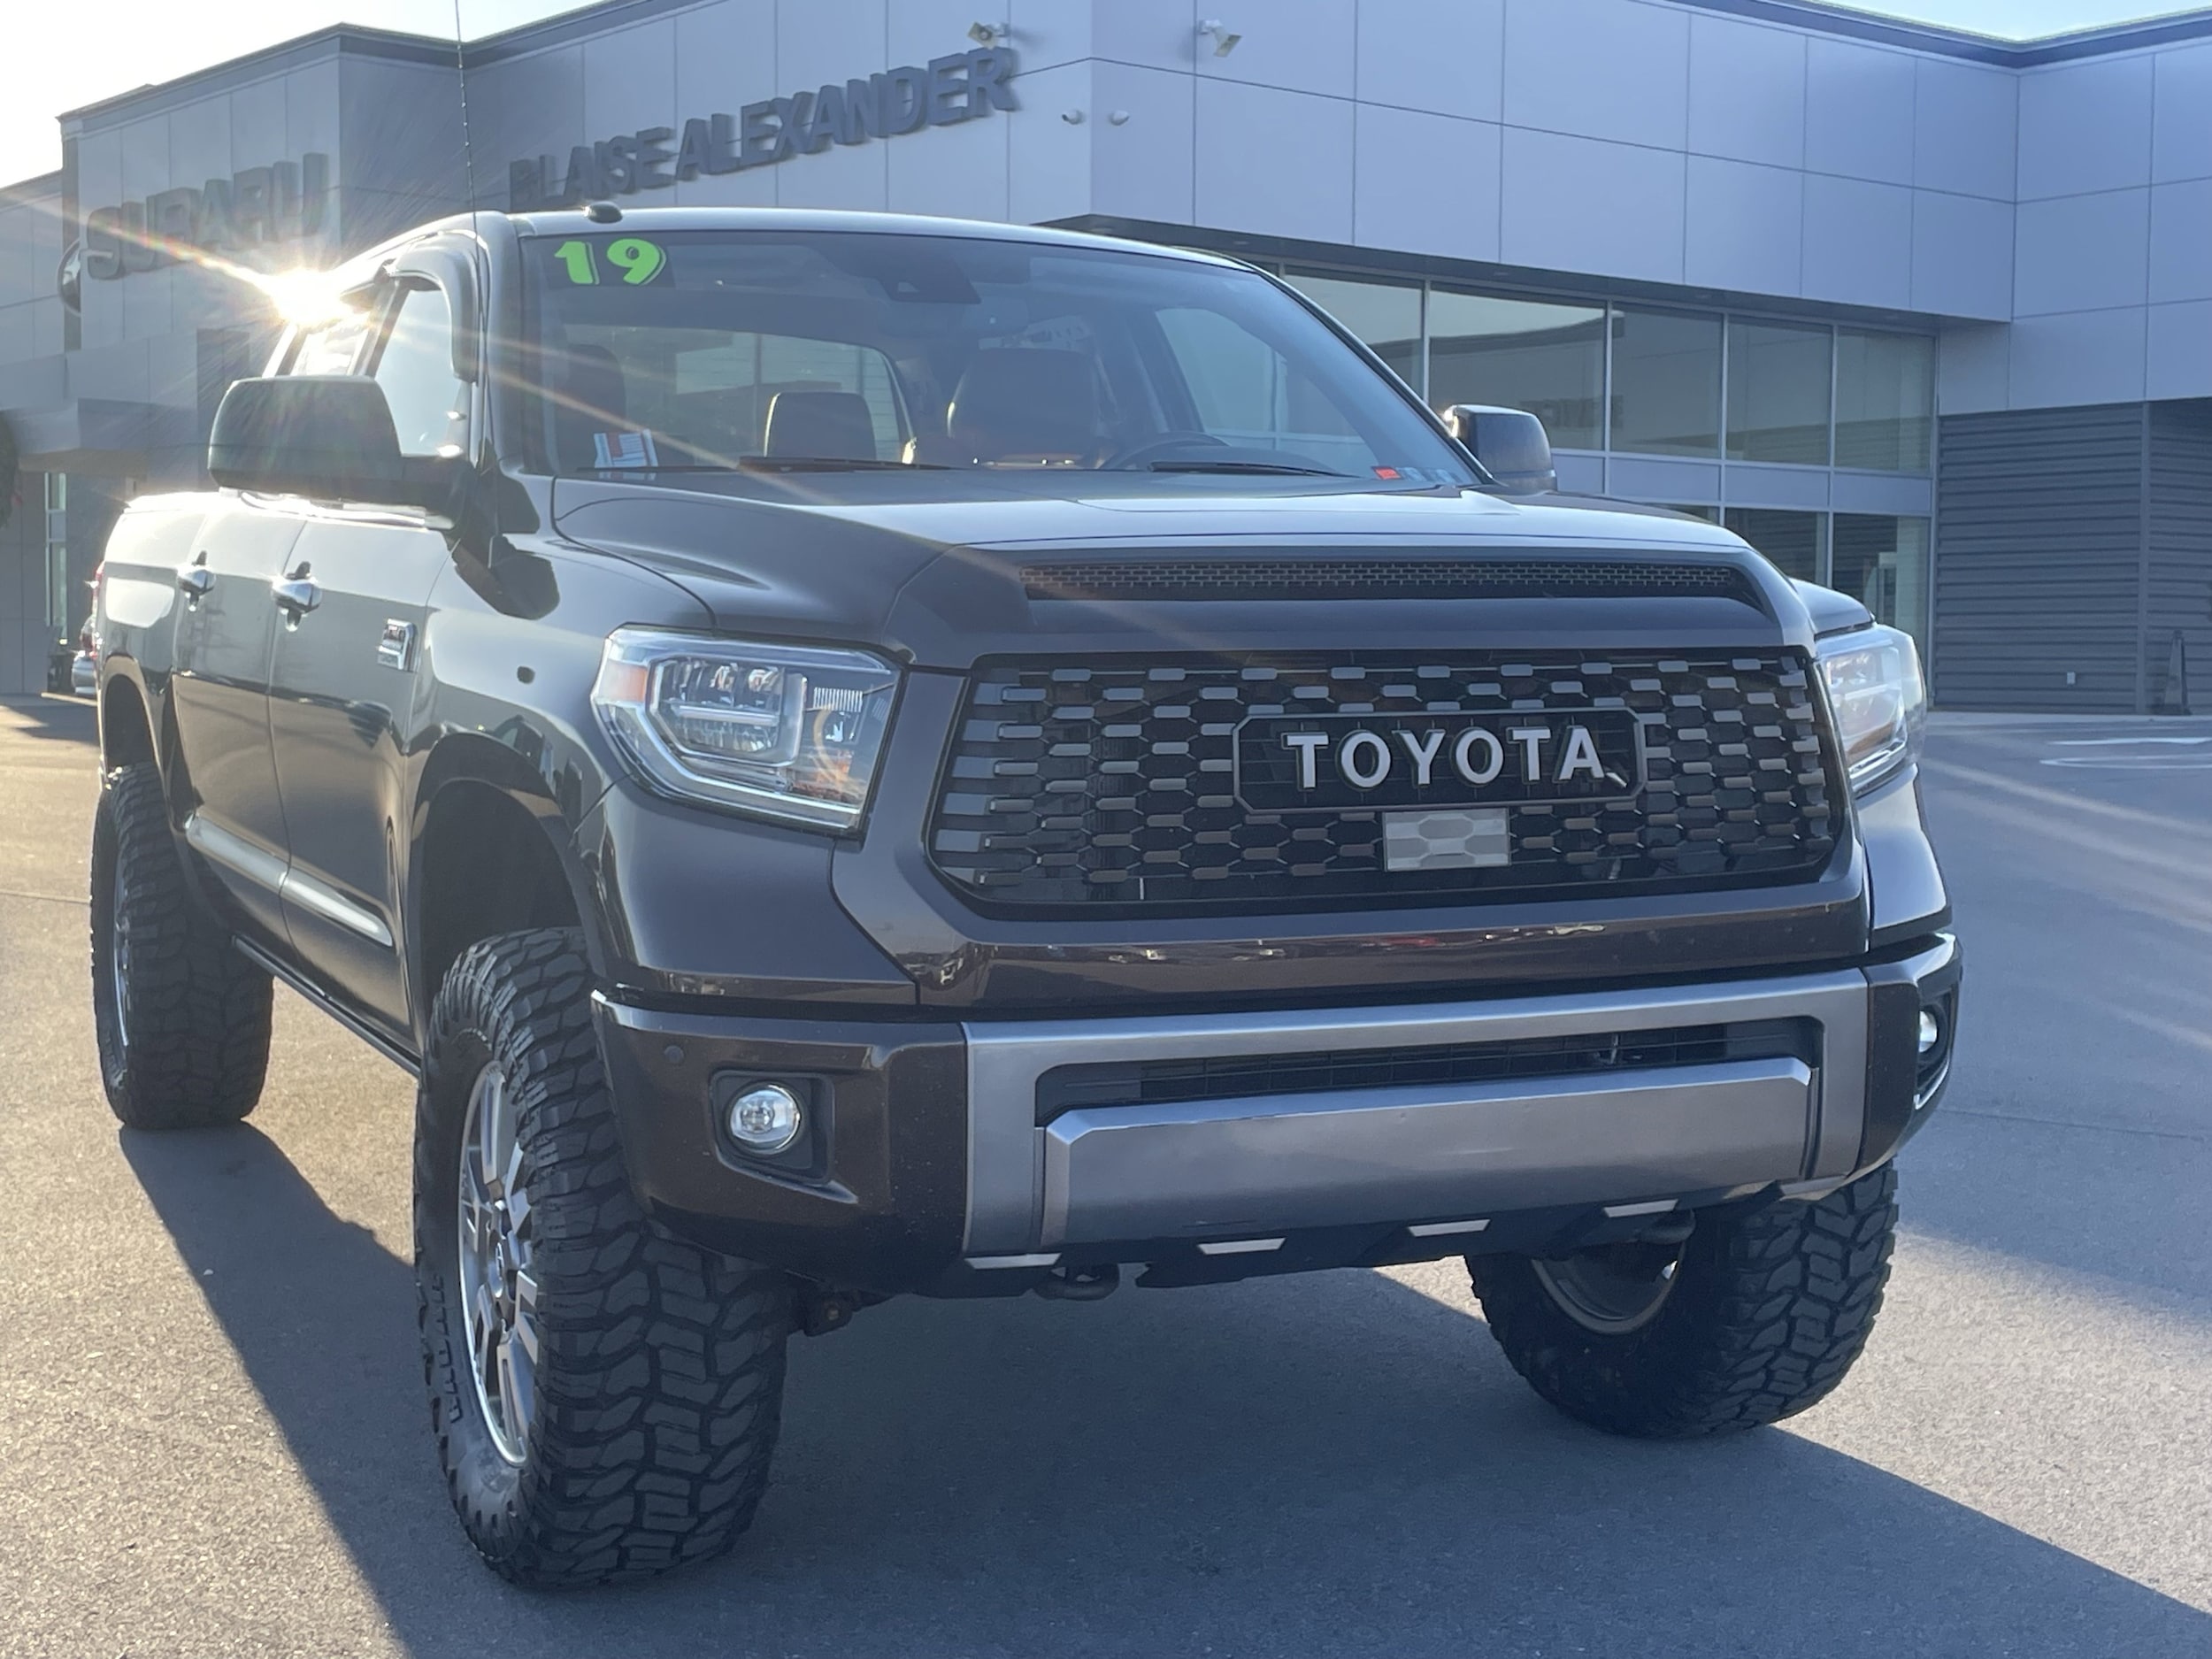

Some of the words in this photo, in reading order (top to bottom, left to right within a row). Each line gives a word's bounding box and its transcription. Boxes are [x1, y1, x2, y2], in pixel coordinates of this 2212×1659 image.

[88, 153, 328, 280] SUBARU
[554, 238, 665, 285] 19
[1283, 726, 1605, 789] TOYOTA
